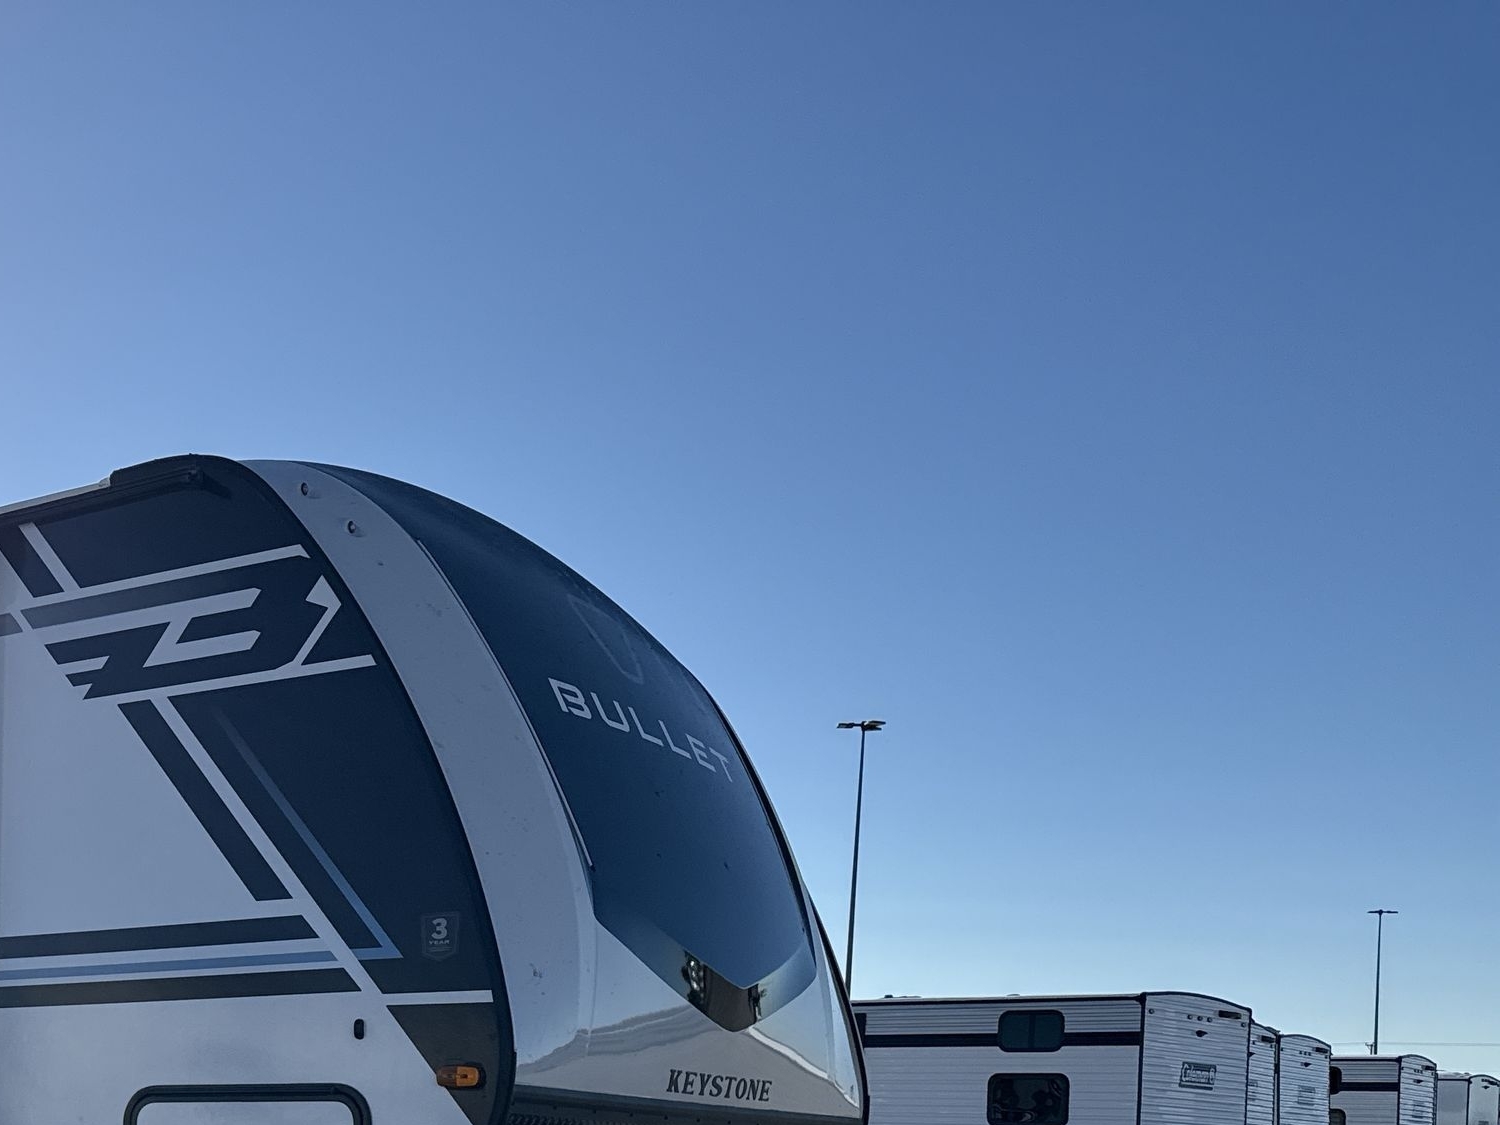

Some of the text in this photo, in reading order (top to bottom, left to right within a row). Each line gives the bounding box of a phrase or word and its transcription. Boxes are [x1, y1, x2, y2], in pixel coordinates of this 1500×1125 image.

[547, 677, 734, 783] BULLET
[431, 917, 448, 940] 3
[666, 1068, 773, 1102] KEYSTONE
